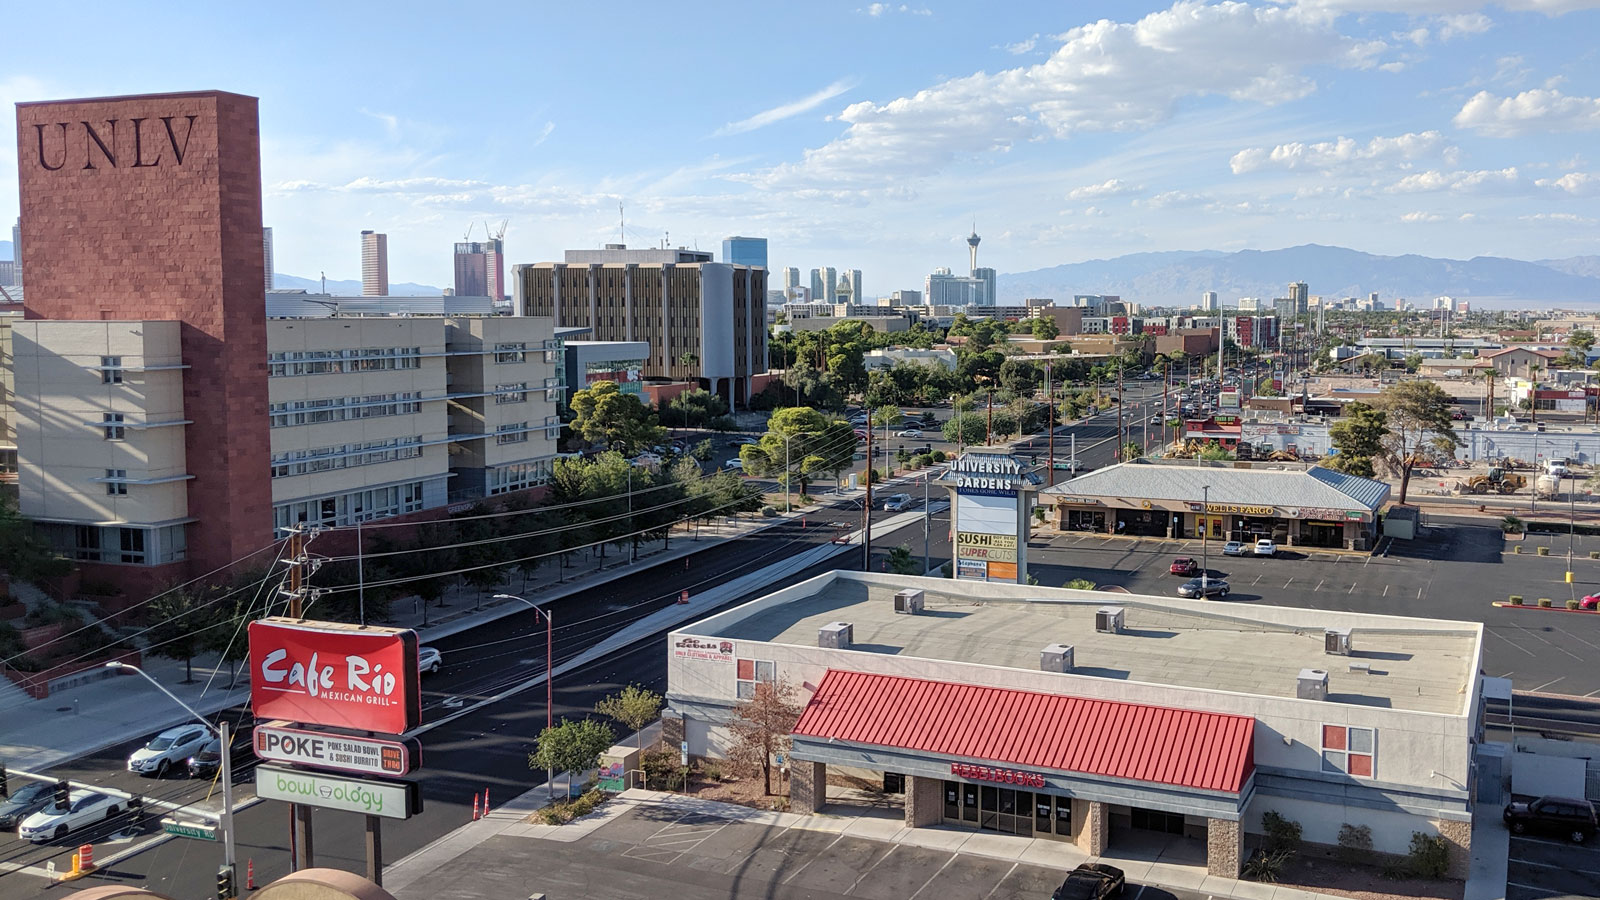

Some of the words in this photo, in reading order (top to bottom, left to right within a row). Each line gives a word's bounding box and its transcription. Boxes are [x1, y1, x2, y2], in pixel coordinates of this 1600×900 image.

[32, 115, 198, 171] UNLV
[950, 460, 1021, 475] UNIVERSITY
[957, 478, 1012, 490] GARDENS
[1205, 504, 1237, 513] WELLS
[1240, 506, 1274, 515] FARGO
[958, 533, 992, 546] SUSHI
[960, 547, 1012, 560] SUPERCUTS
[261, 649, 334, 697] Cafe
[345, 655, 396, 696] Rio
[321, 691, 363, 703] MEXICAN
[365, 696, 390, 706] GRILL
[267, 733, 325, 759] POKE
[327, 741, 342, 751] POKE
[343, 743, 362, 754] SALAD
[362, 746, 380, 757] BOWL
[329, 752, 334, 762] &
[335, 753, 353, 764] SUSHI
[353, 755, 379, 767] BURRITO
